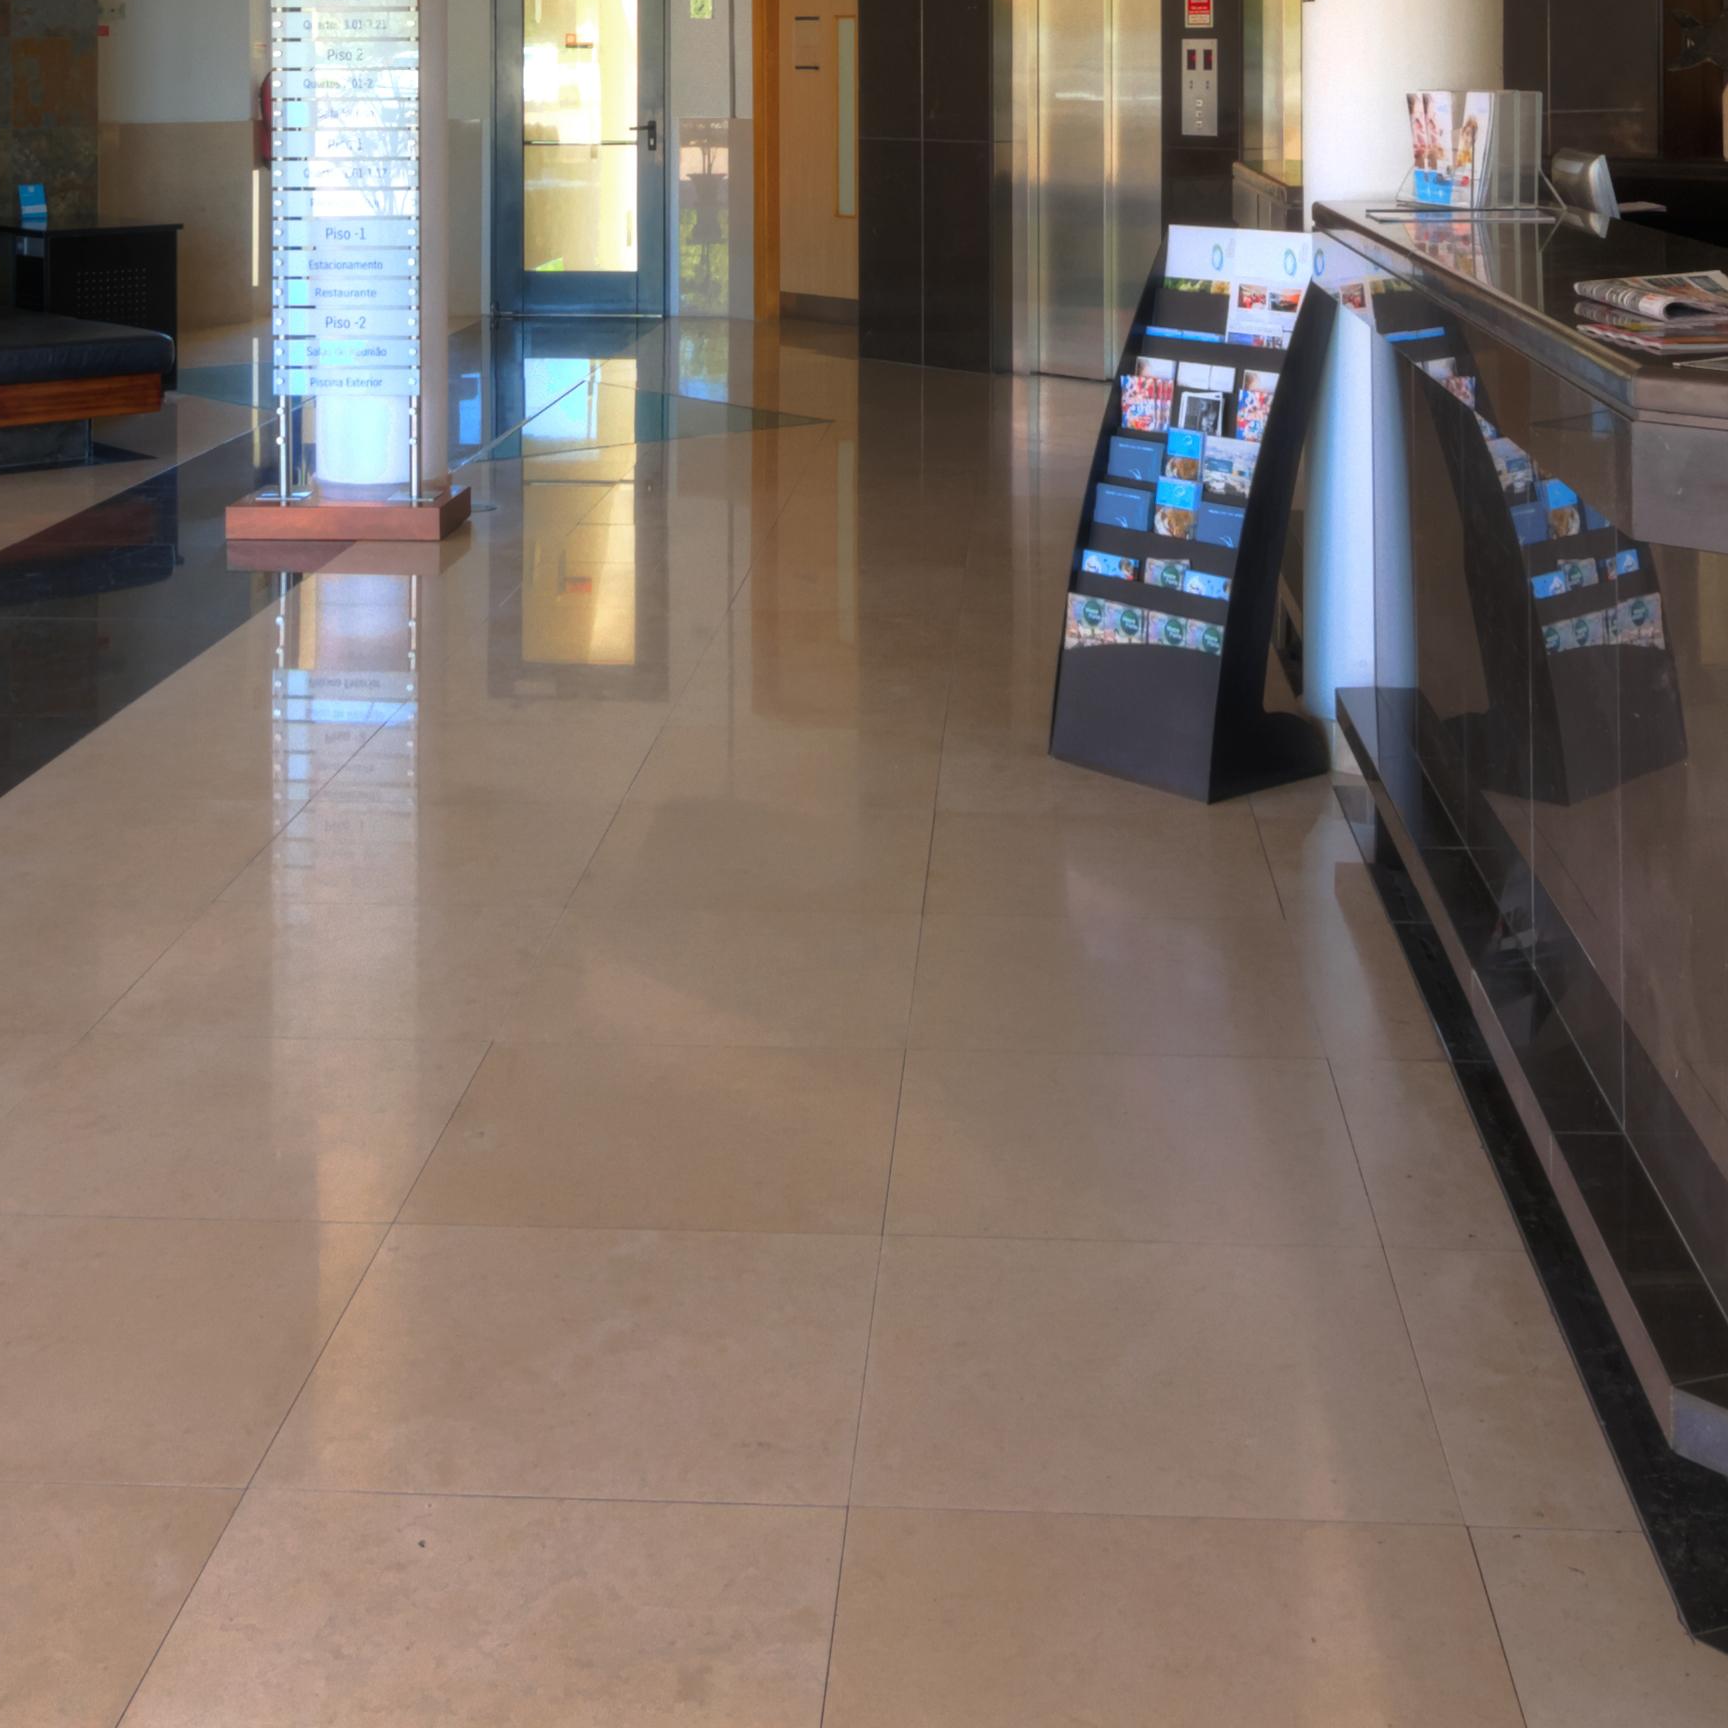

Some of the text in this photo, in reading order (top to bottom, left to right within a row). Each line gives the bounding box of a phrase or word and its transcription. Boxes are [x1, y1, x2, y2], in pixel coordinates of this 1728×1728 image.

[327, 48, 364, 61] Piso 2
[325, 227, 367, 240] Piso -1
[308, 259, 383, 270] Estacionamento
[315, 287, 377, 298] Restaurante
[325, 316, 367, 329] Piso -2
[309, 377, 383, 387] Piscina Exterior
